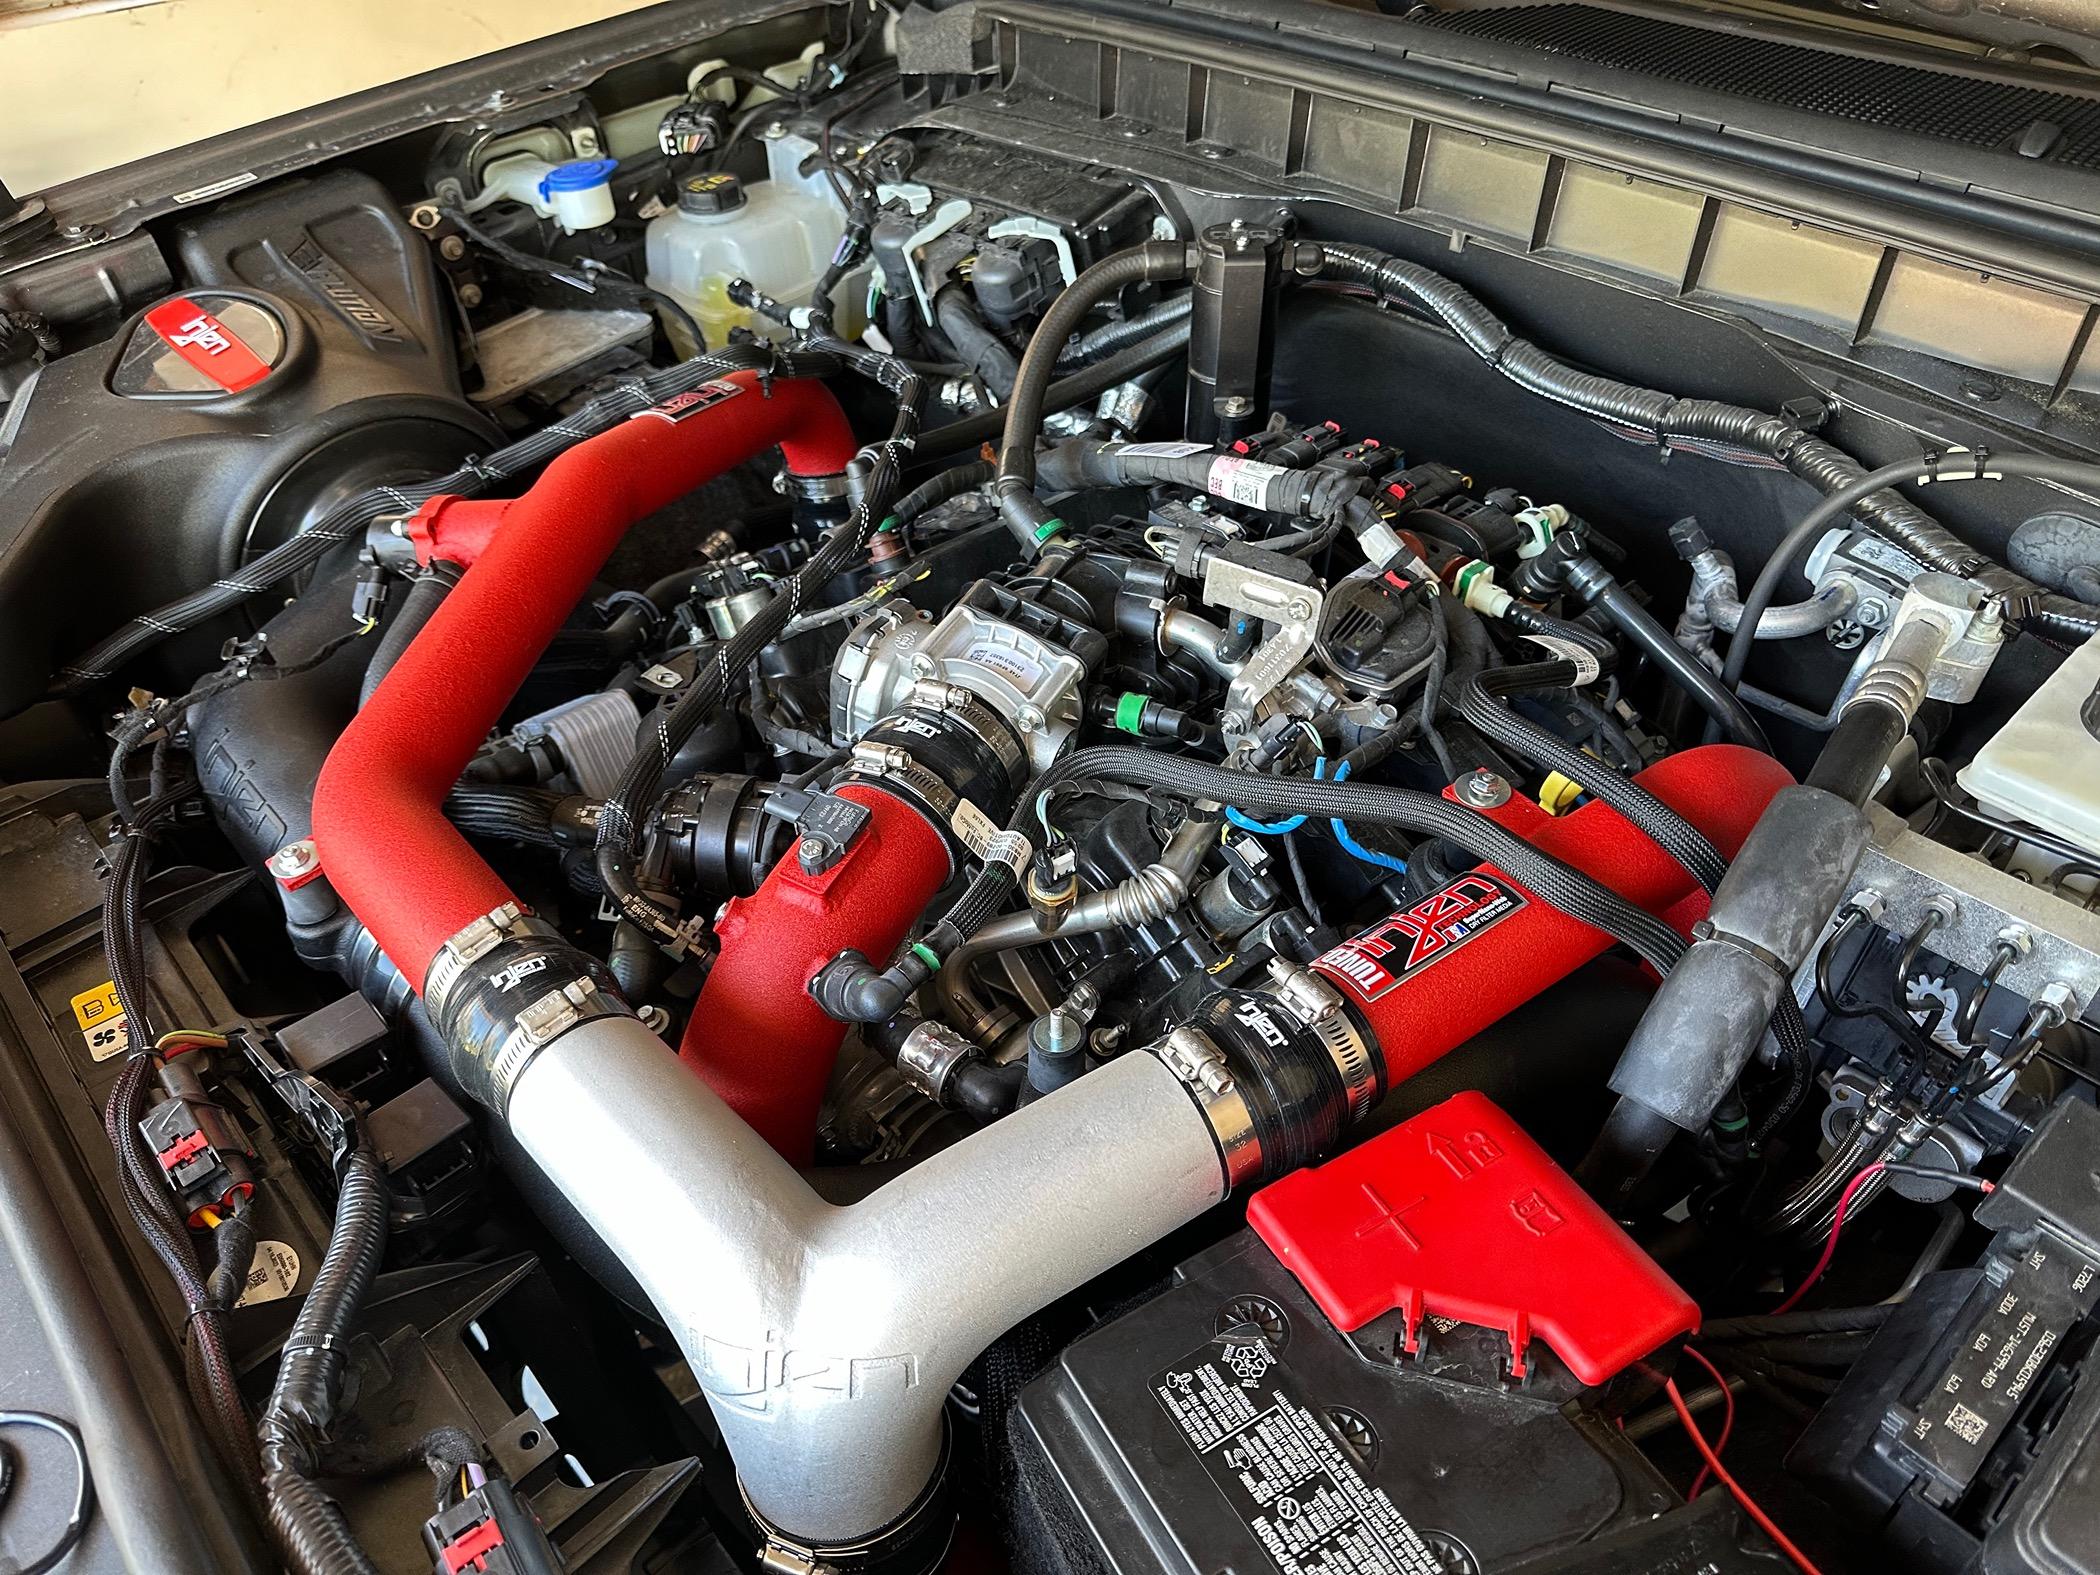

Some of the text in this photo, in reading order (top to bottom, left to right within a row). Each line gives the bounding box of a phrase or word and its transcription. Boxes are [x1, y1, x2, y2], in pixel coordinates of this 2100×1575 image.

[630, 903, 647, 918] ENG
[1435, 888, 1502, 932] TECHNOLOGY
[1468, 918, 1481, 929] DRY
[1479, 909, 1497, 922] FILTER
[1320, 948, 1385, 990] TUNED
[1218, 1384, 1229, 1394] UN
[1178, 1398, 1191, 1411] GET
[1224, 1391, 1248, 1421] CONSULTEZ
[1230, 1382, 1257, 1416] RAPIDEMENT.
[1272, 1389, 1295, 1415] BATTERY!
[1157, 1385, 1206, 1449] FLUSH EYES IMMEDIATELY
[1195, 1405, 1208, 1419] HELP
[1199, 1388, 1233, 1432] RINCEZ LES YEUX
[1204, 1416, 1222, 1438] MEDICAL
[1262, 1416, 1272, 1425] OU
[1273, 1414, 1291, 1435] GRAVES
[1290, 1413, 1305, 1429] OPEN
[1199, 1427, 1214, 1444] WITH
[1279, 1437, 1288, 1446] LA
[1301, 1427, 1314, 1440] NOT
[1255, 1422, 1302, 1481] L'ACIDE SULFURIQUE
[1310, 1438, 1321, 1449] DO
[1323, 1439, 1337, 1453] PAS
[1250, 1435, 1291, 1486] OR SEVERE BURNS
[1283, 1443, 1301, 1463] CAUSER
[1332, 1450, 1343, 1461] NE
[1236, 1432, 1283, 1492] CAN CAUSE BLINDNESS
[1296, 1461, 1310, 1475] PEUT
[1305, 1457, 1318, 1469] DES
[1325, 1458, 1338, 1471] NOT
[1334, 1469, 1345, 1480] DO
[1238, 1470, 1266, 1504] SULFURIC
[1257, 1479, 1275, 1498] ACID
[1360, 1487, 1374, 1502] DES
[1301, 1501, 1314, 1514] LES
[1329, 1490, 1354, 1517] DE FUMER
[1372, 1487, 1400, 1519] BATTERIE!
[1333, 1510, 1345, 1523] LES
[1362, 1508, 1374, 1518] OF
[1295, 1515, 1318, 1542] SMOKING
[1369, 1515, 1388, 1537] REACH
[1387, 1522, 1398, 1534] LA
[1394, 1516, 1407, 1528] LA
[1273, 1516, 1301, 1554] NO SPARKS,
[1336, 1533, 1351, 1548] LES
[1383, 1534, 1397, 1549] THE
[1393, 1531, 1405, 1543] DE
[1401, 1525, 1424, 1552] OUVRIR
[1344, 1544, 1363, 1565] YEUX
[1354, 1522, 1395, 1573] OU RENDRE AVEUGLE
[1392, 1547, 1404, 1557] OF
[1401, 1540, 1419, 1561] HORS
[1332, 1549, 1353, 1573] INJURY
[1399, 1555, 1414, 1570] OUT
[1420, 1549, 1435, 1565] PAS
